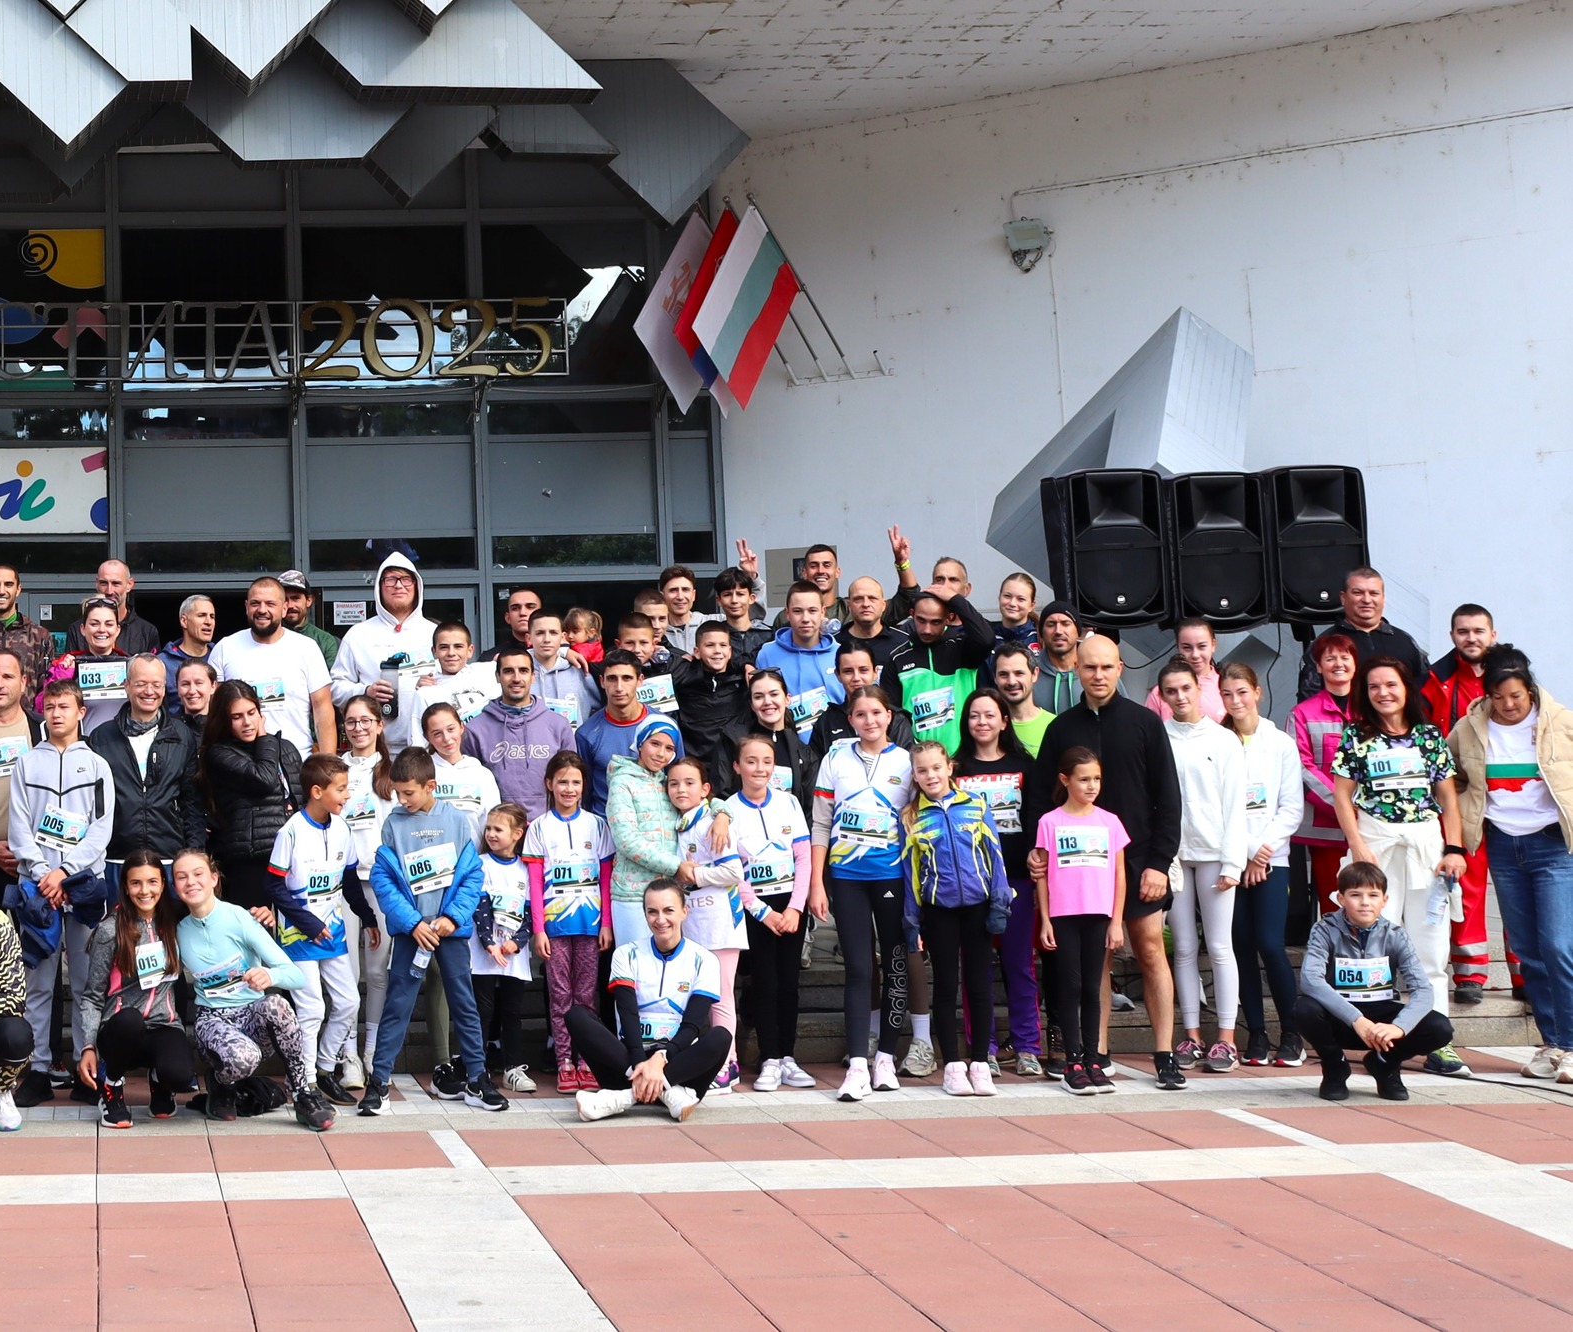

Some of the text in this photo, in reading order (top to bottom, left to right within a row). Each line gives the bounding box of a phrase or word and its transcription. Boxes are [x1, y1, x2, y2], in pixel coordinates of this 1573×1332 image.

[298, 296, 552, 377] 2025
[81, 672, 102, 685] 033
[914, 703, 931, 717] 018
[1372, 760, 1392, 774] 101
[42, 814, 65, 832] 005
[842, 812, 860, 826] 027
[1058, 836, 1078, 849] 113
[409, 860, 432, 877] 086
[554, 867, 572, 880] 071
[751, 864, 773, 878] 028
[309, 875, 330, 888] 029
[138, 955, 159, 971] 015
[1338, 969, 1363, 983] 054
[888, 943, 909, 1029] adidas
